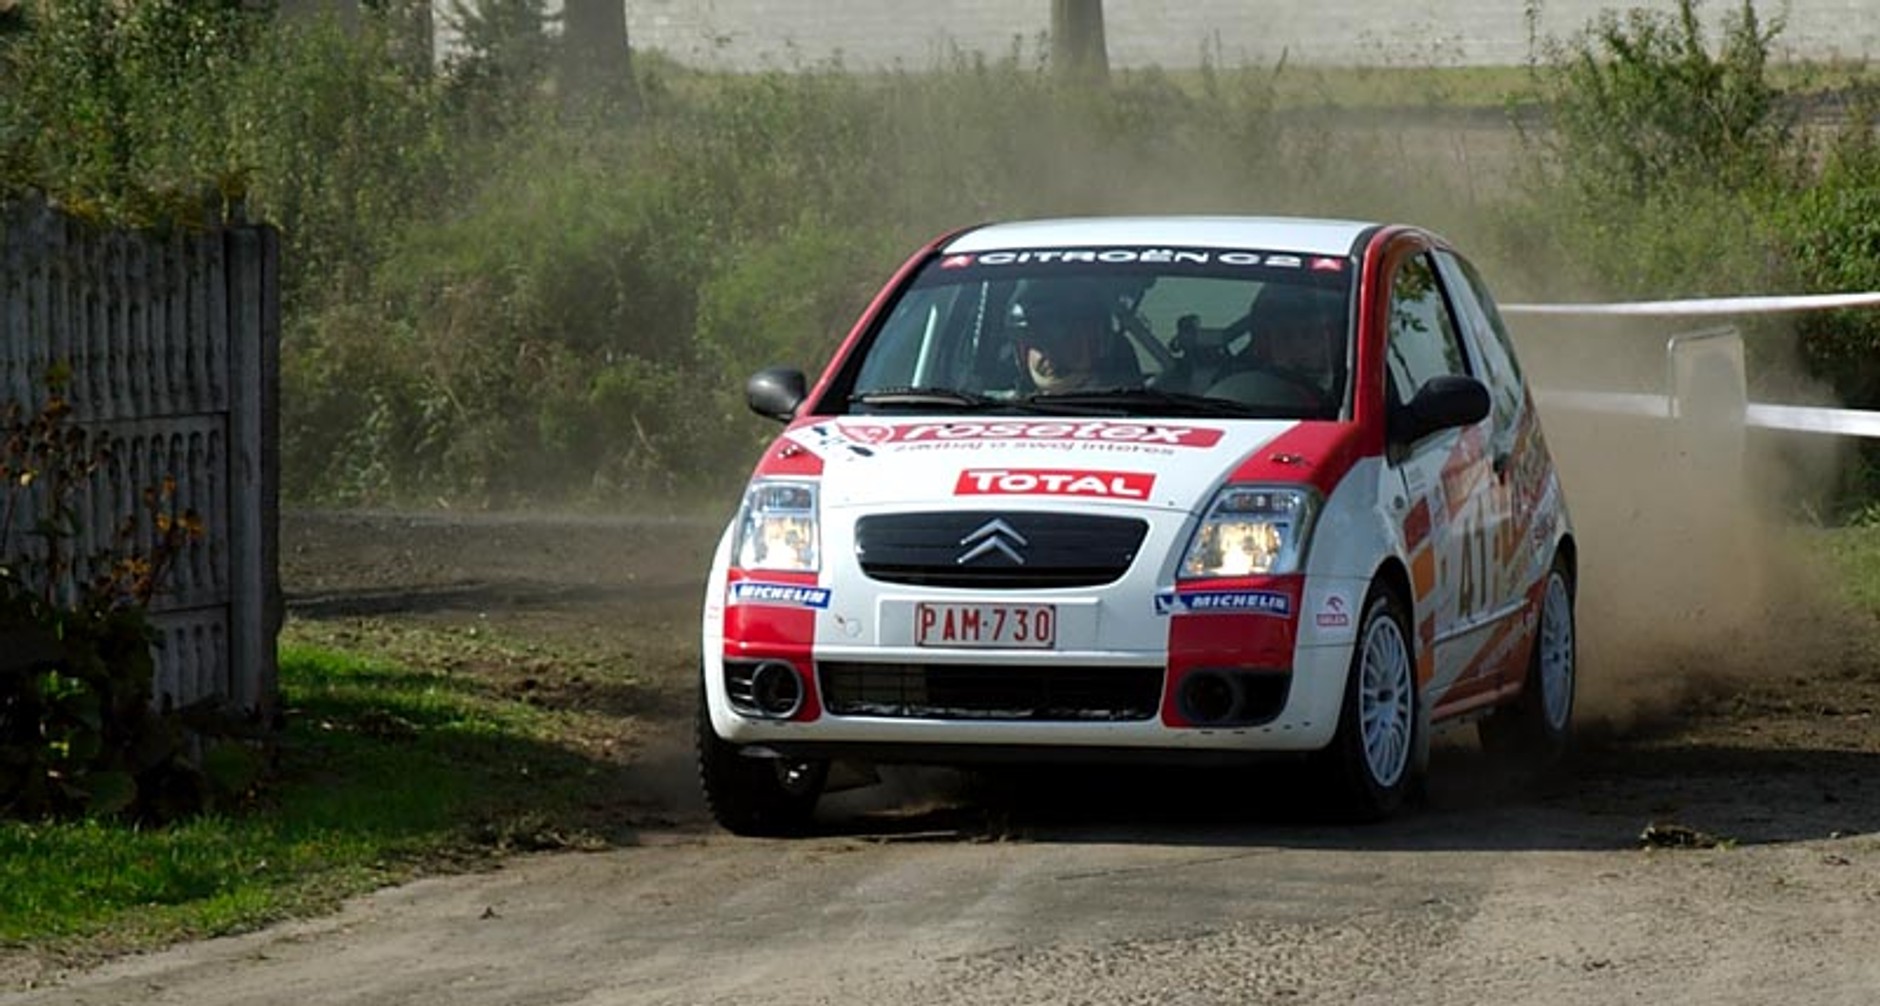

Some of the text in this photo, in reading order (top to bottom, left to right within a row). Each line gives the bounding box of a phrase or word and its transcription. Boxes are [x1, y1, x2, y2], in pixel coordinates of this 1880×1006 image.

[978, 248, 1302, 268] CITROËN C2
[902, 422, 1193, 446] rosetex
[1081, 441, 1174, 456] interes
[967, 468, 1143, 497] TOTAL
[738, 583, 828, 604] MICHELIN
[1191, 594, 1286, 611] MICHELIN
